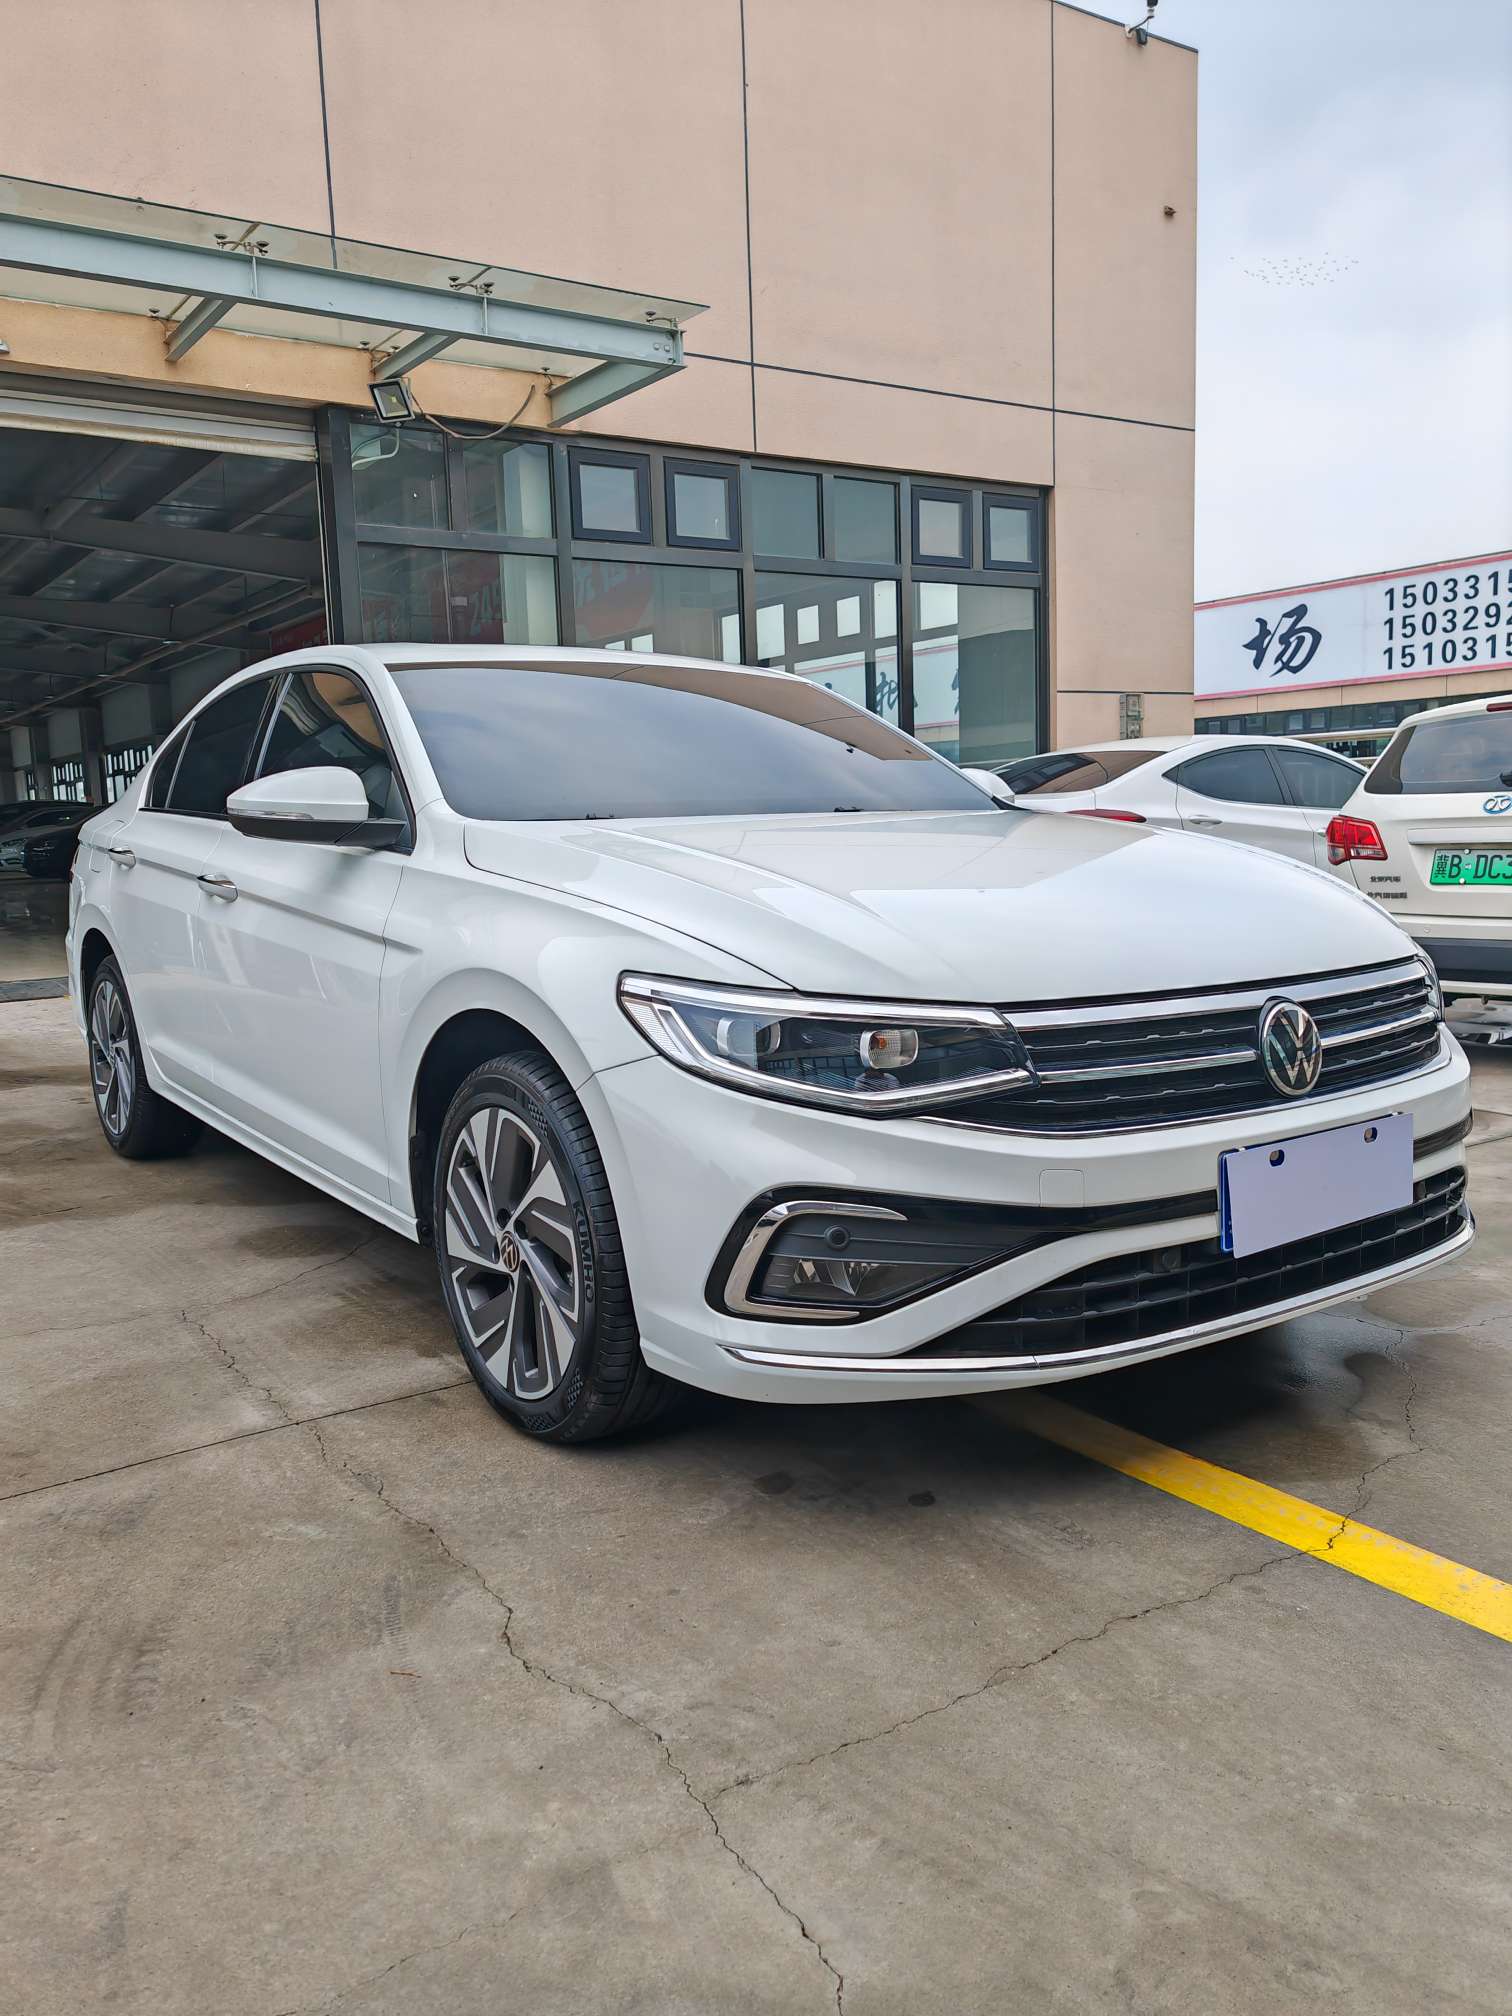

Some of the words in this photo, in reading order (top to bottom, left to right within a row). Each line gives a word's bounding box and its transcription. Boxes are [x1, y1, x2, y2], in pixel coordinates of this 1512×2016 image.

[1383, 569, 1512, 612] 150331
[1242, 603, 1323, 677] 场
[572, 1200, 594, 1304] KUMHO
